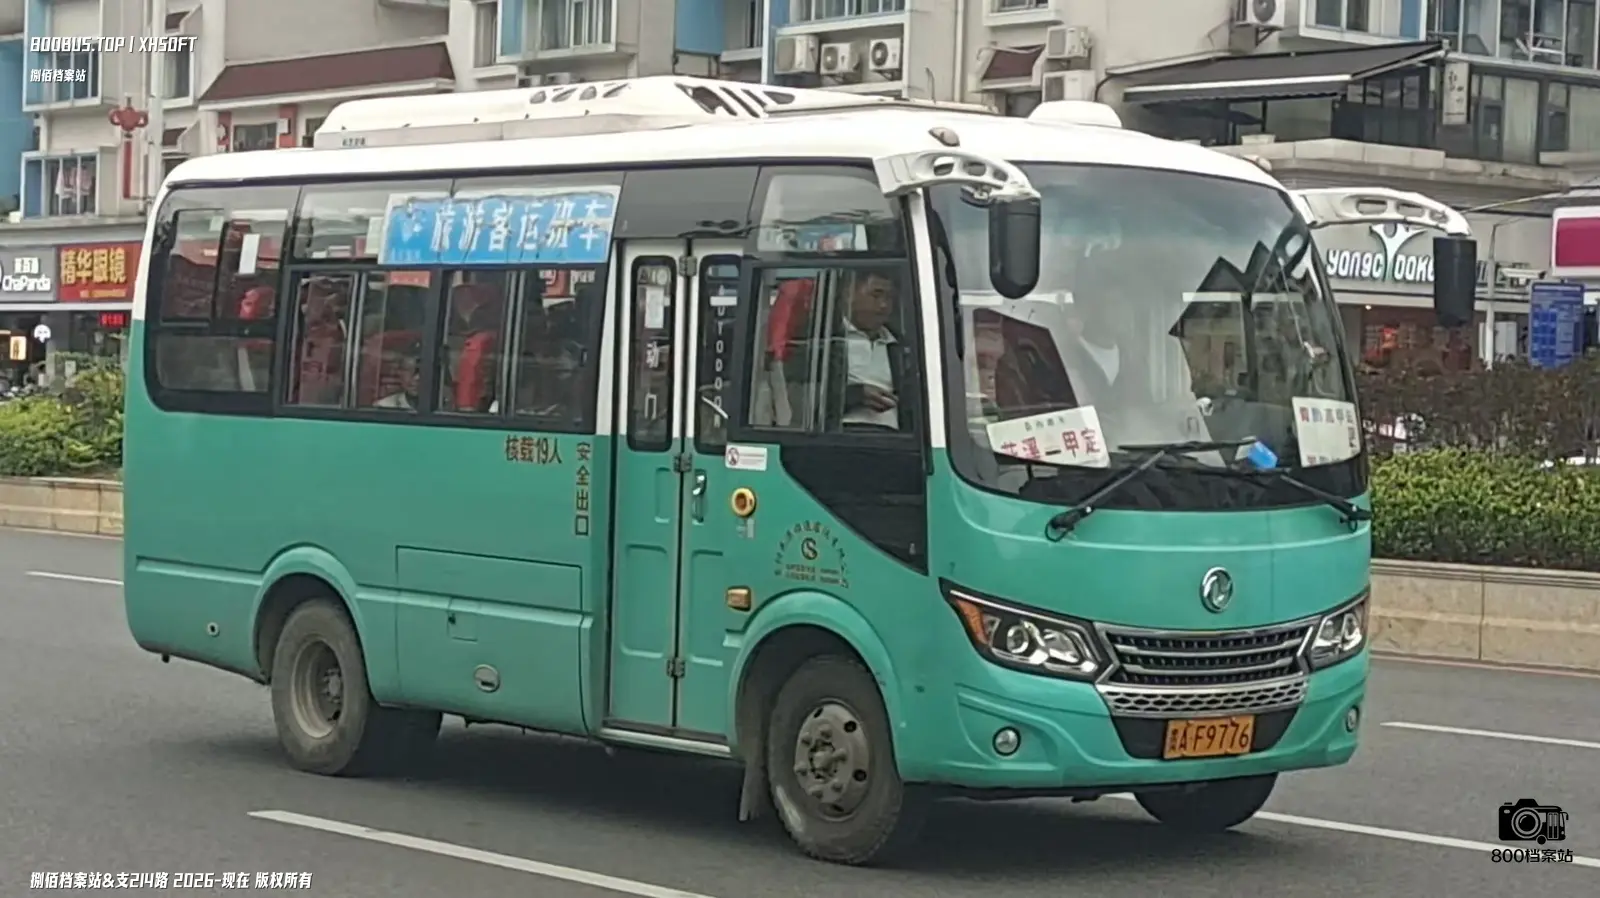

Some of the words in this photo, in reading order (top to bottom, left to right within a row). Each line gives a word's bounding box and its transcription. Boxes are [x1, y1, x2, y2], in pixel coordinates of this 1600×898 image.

[61, 247, 126, 284] 精华眼镜
[505, 435, 562, 464] 核载19人
[575, 441, 591, 536] 安全出口
